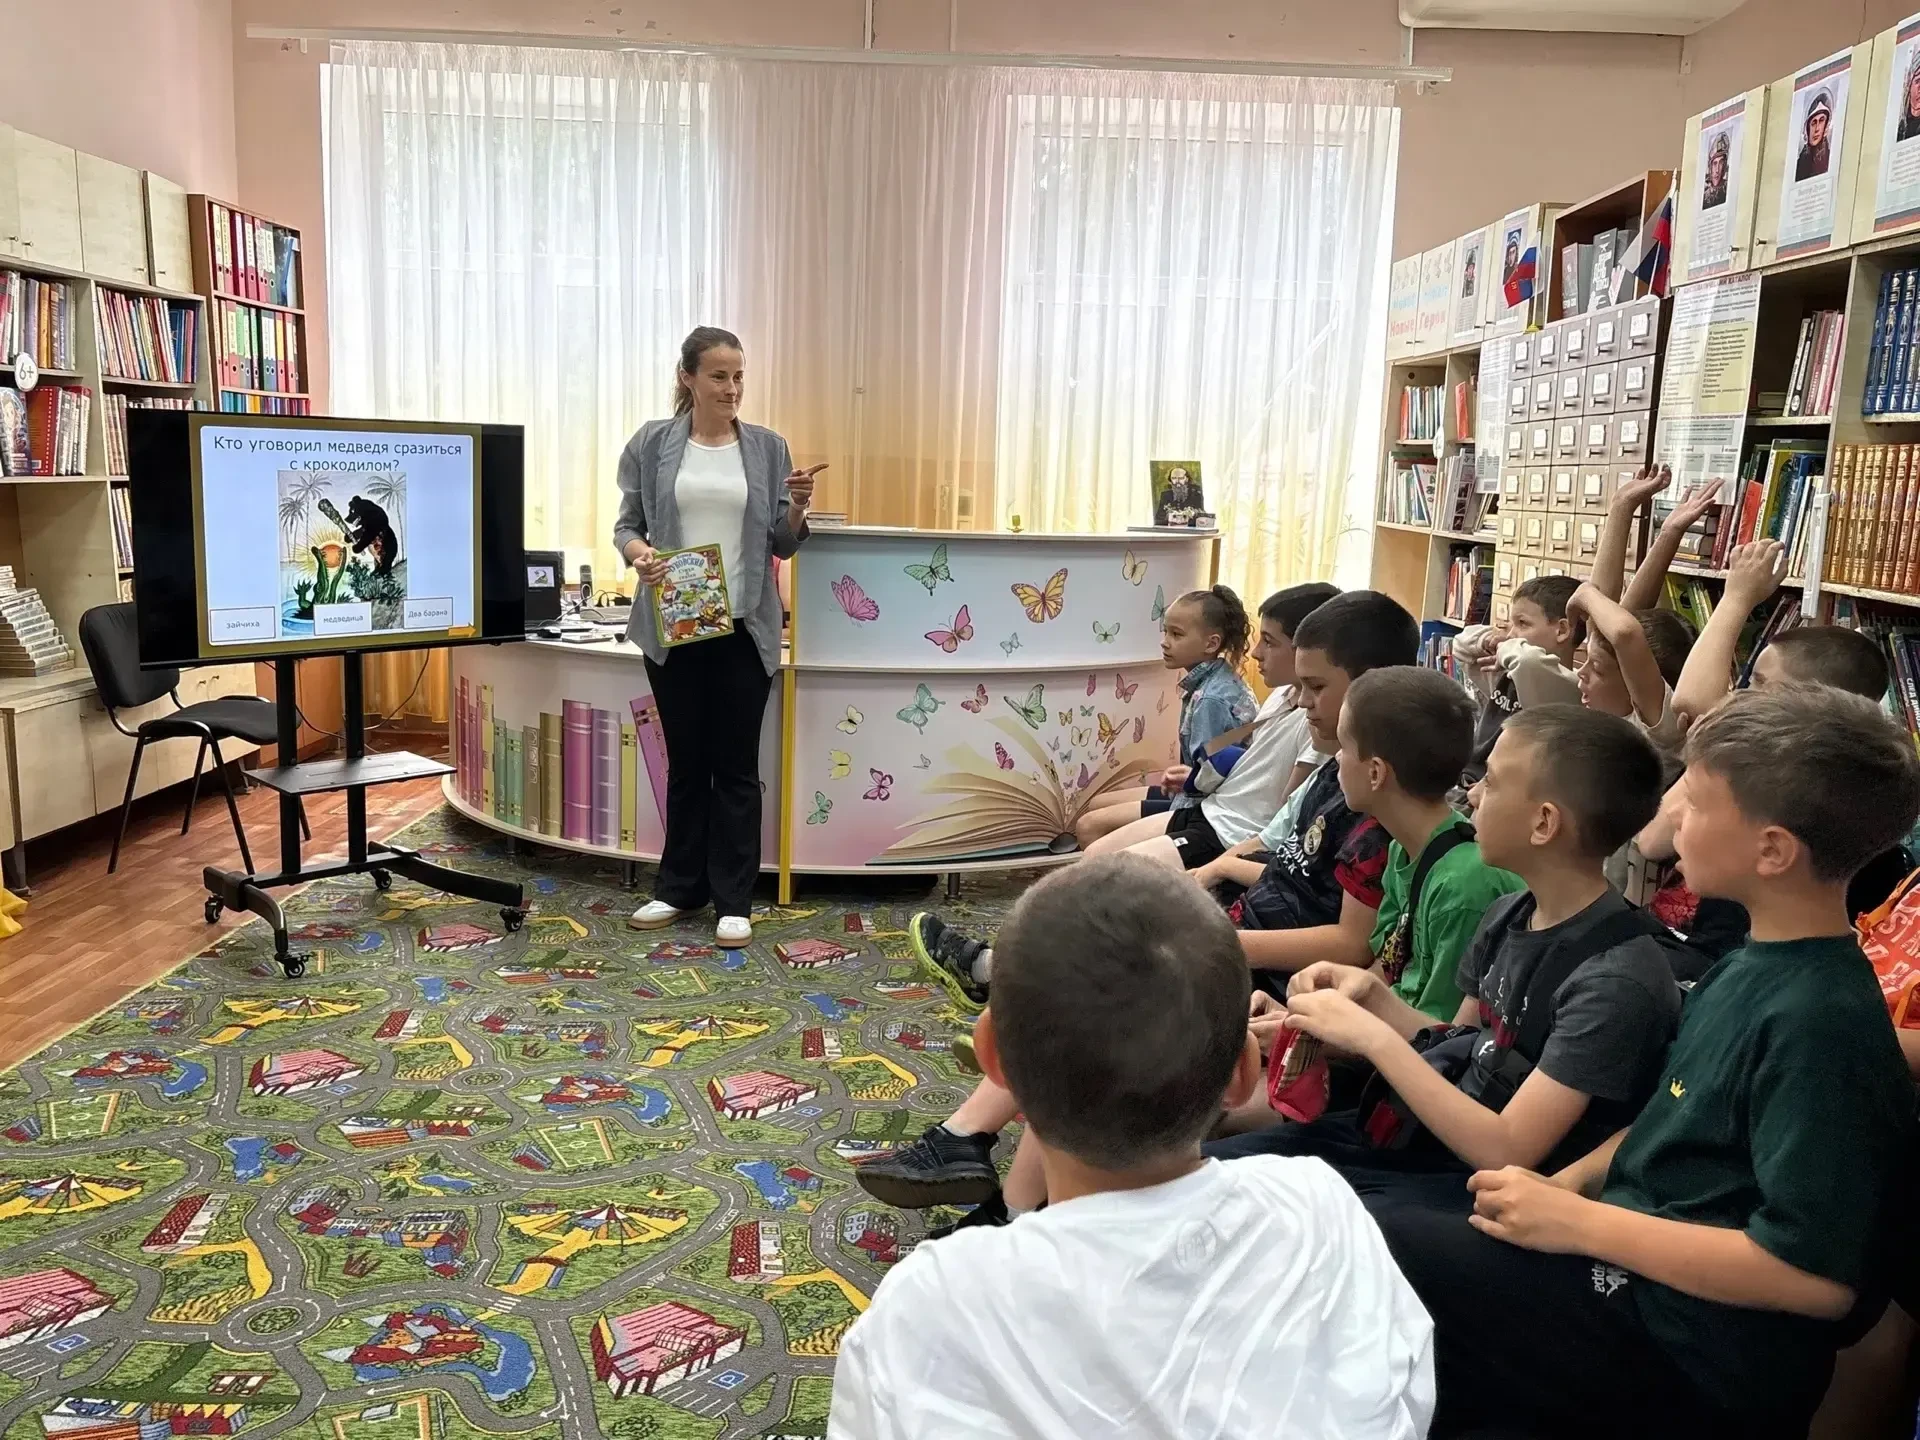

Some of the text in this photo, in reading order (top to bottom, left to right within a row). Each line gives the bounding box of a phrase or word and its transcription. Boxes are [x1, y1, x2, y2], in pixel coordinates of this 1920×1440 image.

[19, 362, 34, 380] 6+
[214, 435, 462, 456] Кто уговорил медведя сразиться
[289, 460, 399, 473] с крокодилом?
[323, 614, 364, 624] медведица
[408, 608, 448, 619] Два барана
[226, 619, 261, 630] зайчиха
[715, 1208, 740, 1231] BUS
